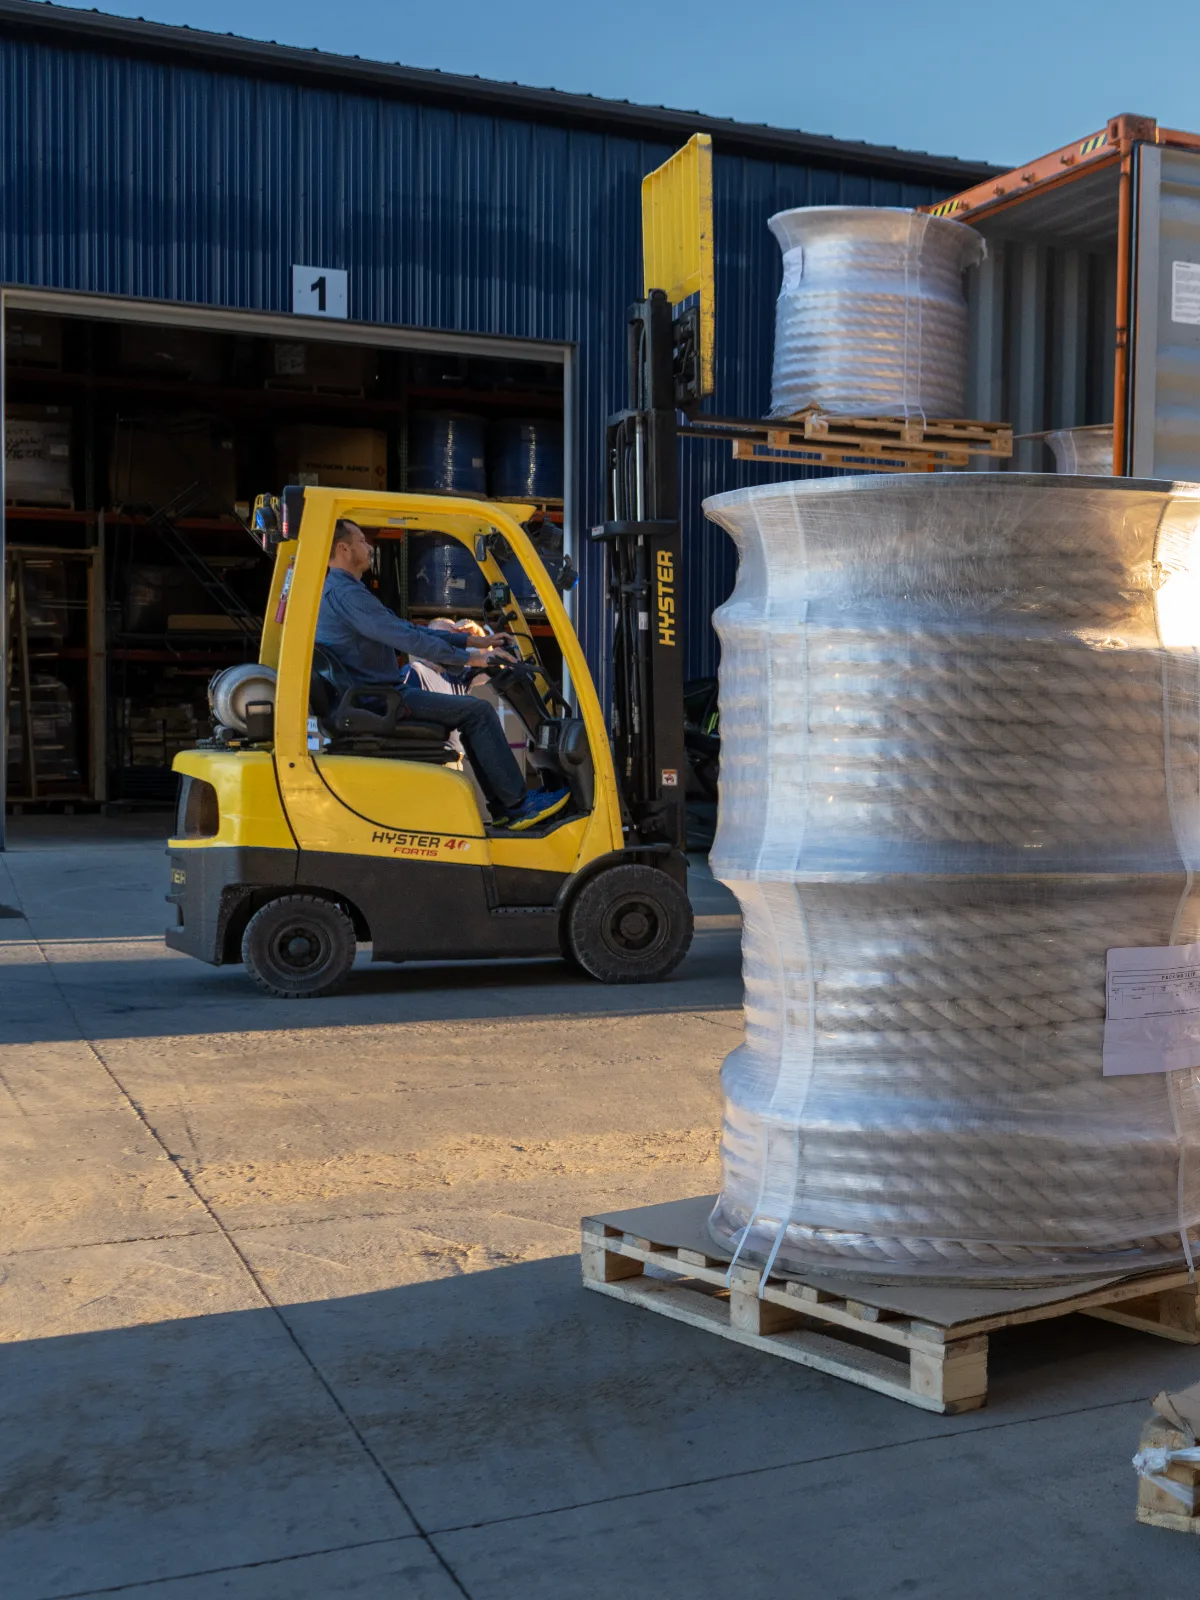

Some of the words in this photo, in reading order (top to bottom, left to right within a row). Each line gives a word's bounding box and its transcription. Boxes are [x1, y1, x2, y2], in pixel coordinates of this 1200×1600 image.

[310, 276, 326, 311] 1
[657, 550, 676, 646] HYSTER
[372, 831, 440, 848] HYSTER
[393, 847, 438, 857] FORTIS
